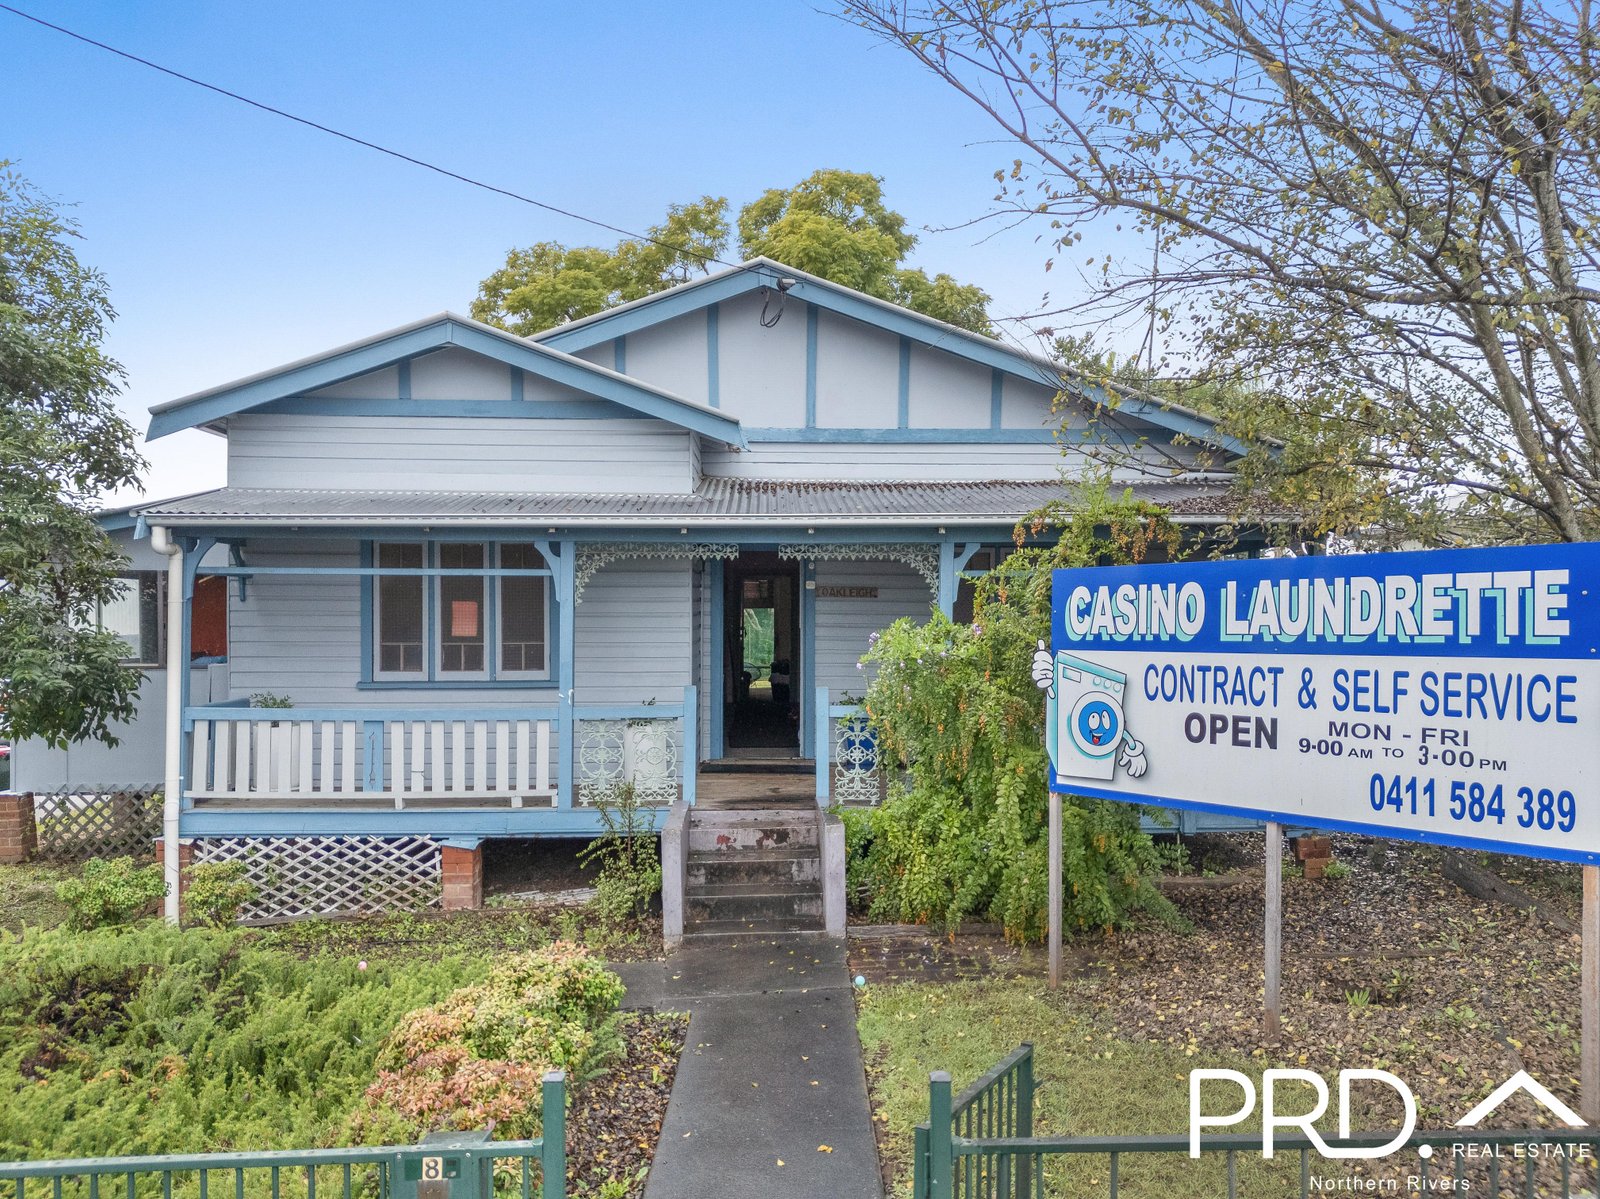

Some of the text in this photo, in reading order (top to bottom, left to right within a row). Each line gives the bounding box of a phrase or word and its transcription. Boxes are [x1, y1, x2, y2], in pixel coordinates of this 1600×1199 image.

[1065, 569, 1570, 645] CASINO LAUNDRETTE
[1143, 663, 1578, 724] CONTRACT & SELF SERVICE
[1184, 712, 1279, 750] OPEN
[1328, 720, 1392, 740] MON
[1421, 727, 1470, 747] FRI
[1348, 747, 1373, 759] AM
[1382, 747, 1404, 758] TO
[1479, 759, 1507, 771] PM
[1370, 772, 1576, 832] 0411 584 389
[425, 1158, 440, 1179] 8
